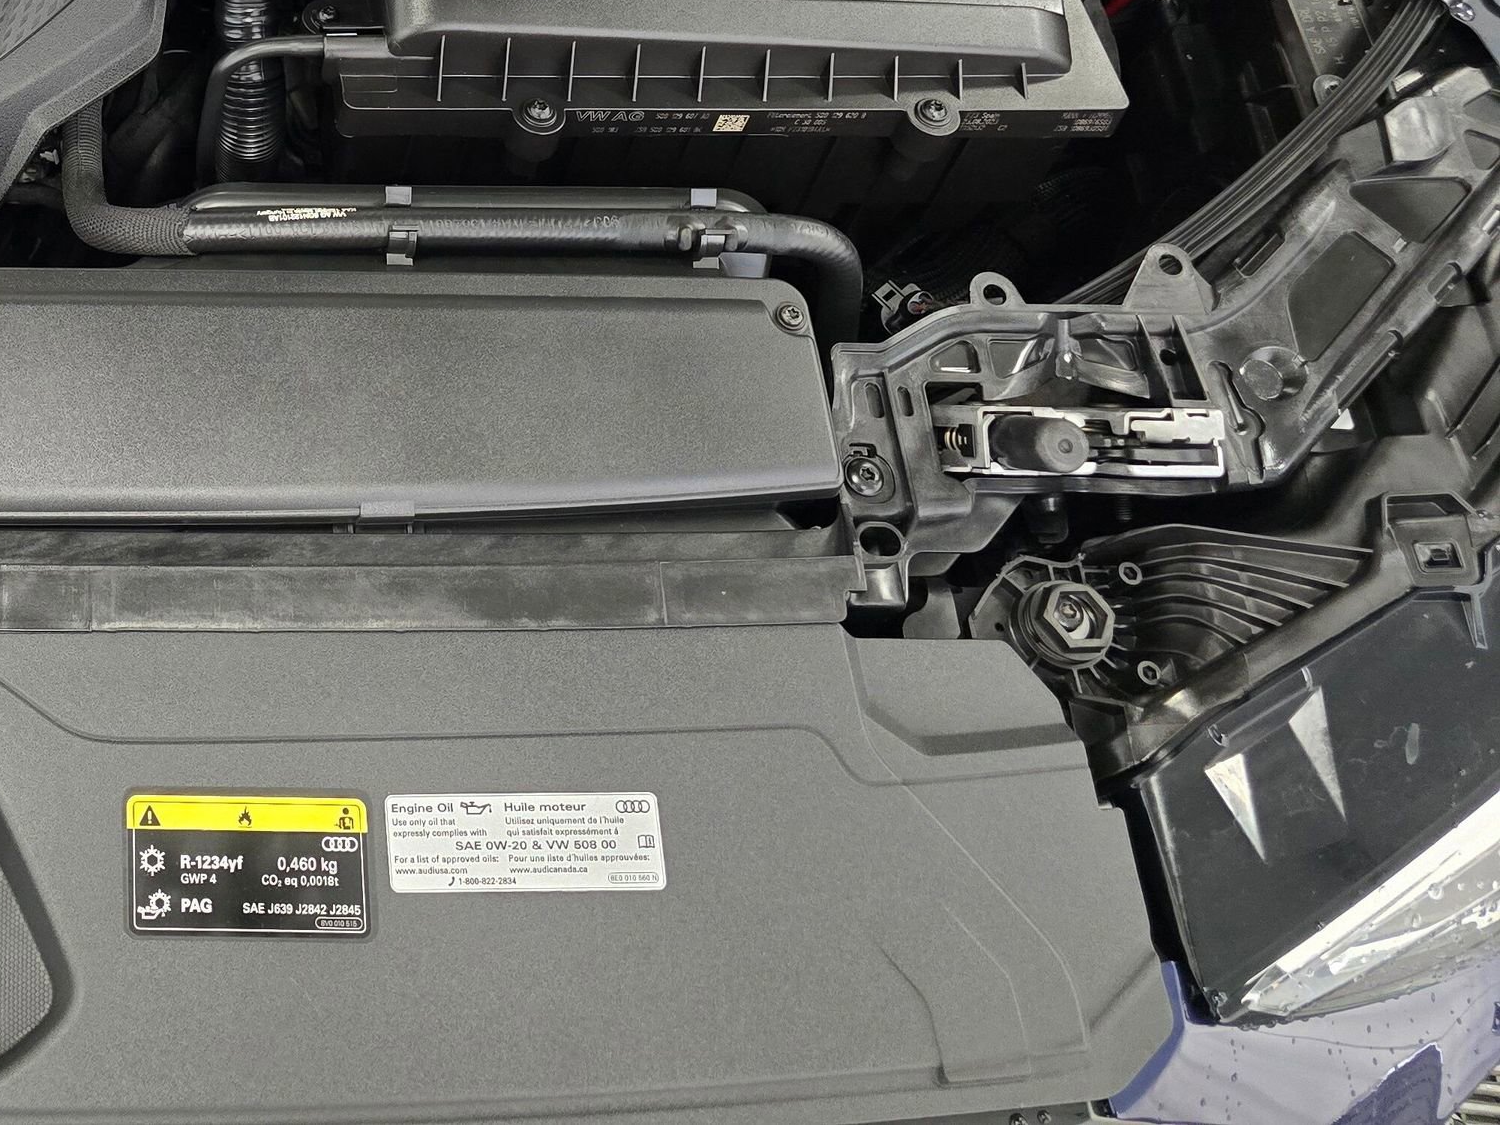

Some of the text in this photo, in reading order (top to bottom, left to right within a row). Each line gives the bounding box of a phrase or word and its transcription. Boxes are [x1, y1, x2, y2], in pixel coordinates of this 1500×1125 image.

[575, 110, 612, 122] VW
[611, 110, 645, 122] AG
[391, 802, 454, 815] Engine Oil
[504, 802, 587, 812] Huile moteur
[392, 818, 456, 828] Use only oil that
[505, 817, 535, 825] Utilisez
[536, 817, 586, 826] uniquement
[599, 816, 625, 824] l'huile
[393, 828, 488, 839] expressly complies with
[506, 828, 520, 837] qui
[521, 828, 554, 836] satisfait
[555, 828, 613, 837] expressément
[455, 839, 617, 851] SAE 0W-20 & VW 508 00
[180, 854, 244, 873] R-1234yf
[394, 855, 408, 864] For
[416, 856, 430, 864] list
[431, 855, 440, 864] of
[441, 855, 480, 865] approved
[482, 854, 500, 863] oils:
[508, 854, 528, 862] Pour
[566, 854, 599, 863] d'huiles
[600, 854, 651, 863] approuvées:
[277, 857, 338, 875] 0,460 kg
[395, 866, 468, 875] www.audiusa.com
[509, 865, 588, 873] www.audicanada.ca
[180, 873, 217, 885] GWP 4
[284, 877, 298, 888] eq
[300, 876, 339, 888] 0,0018t
[458, 877, 517, 885] 1-800-822-2834
[181, 898, 213, 914] PAG
[243, 903, 361, 916] SAE J639 J2842 J2845
